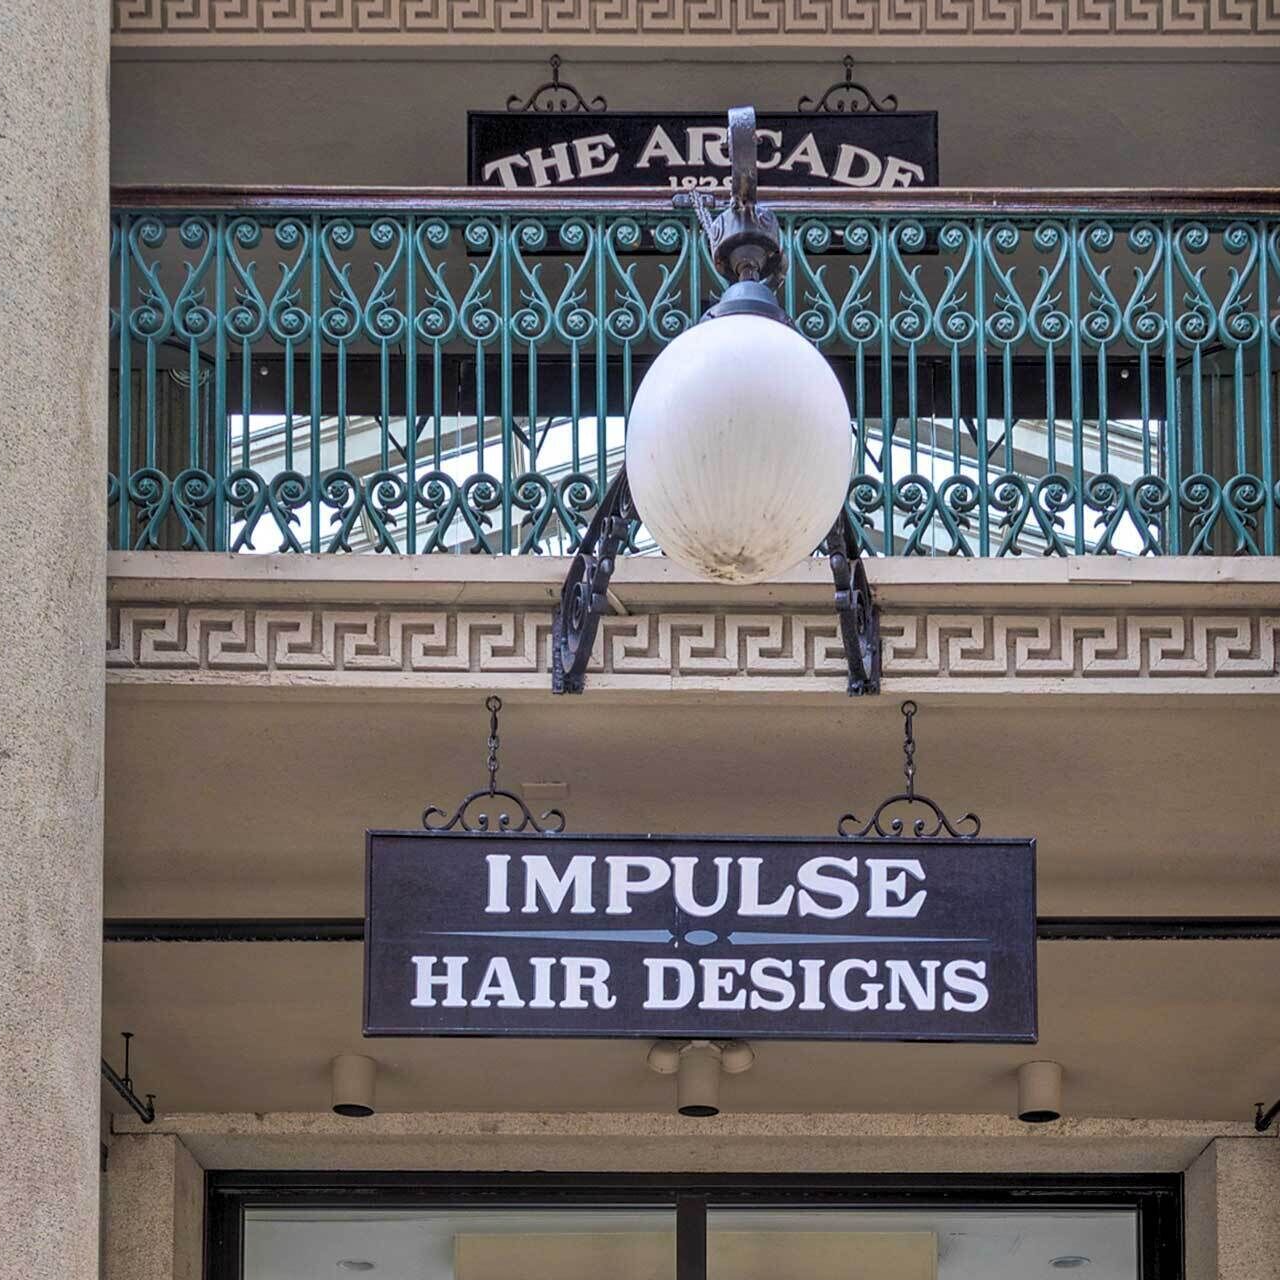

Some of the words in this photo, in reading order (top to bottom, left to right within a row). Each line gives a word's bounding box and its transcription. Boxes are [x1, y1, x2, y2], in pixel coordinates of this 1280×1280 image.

[483, 133, 620, 188] THE
[484, 854, 927, 918] IMPULSE
[410, 956, 617, 1010] HAIR
[643, 957, 989, 1013] DESIGNS
